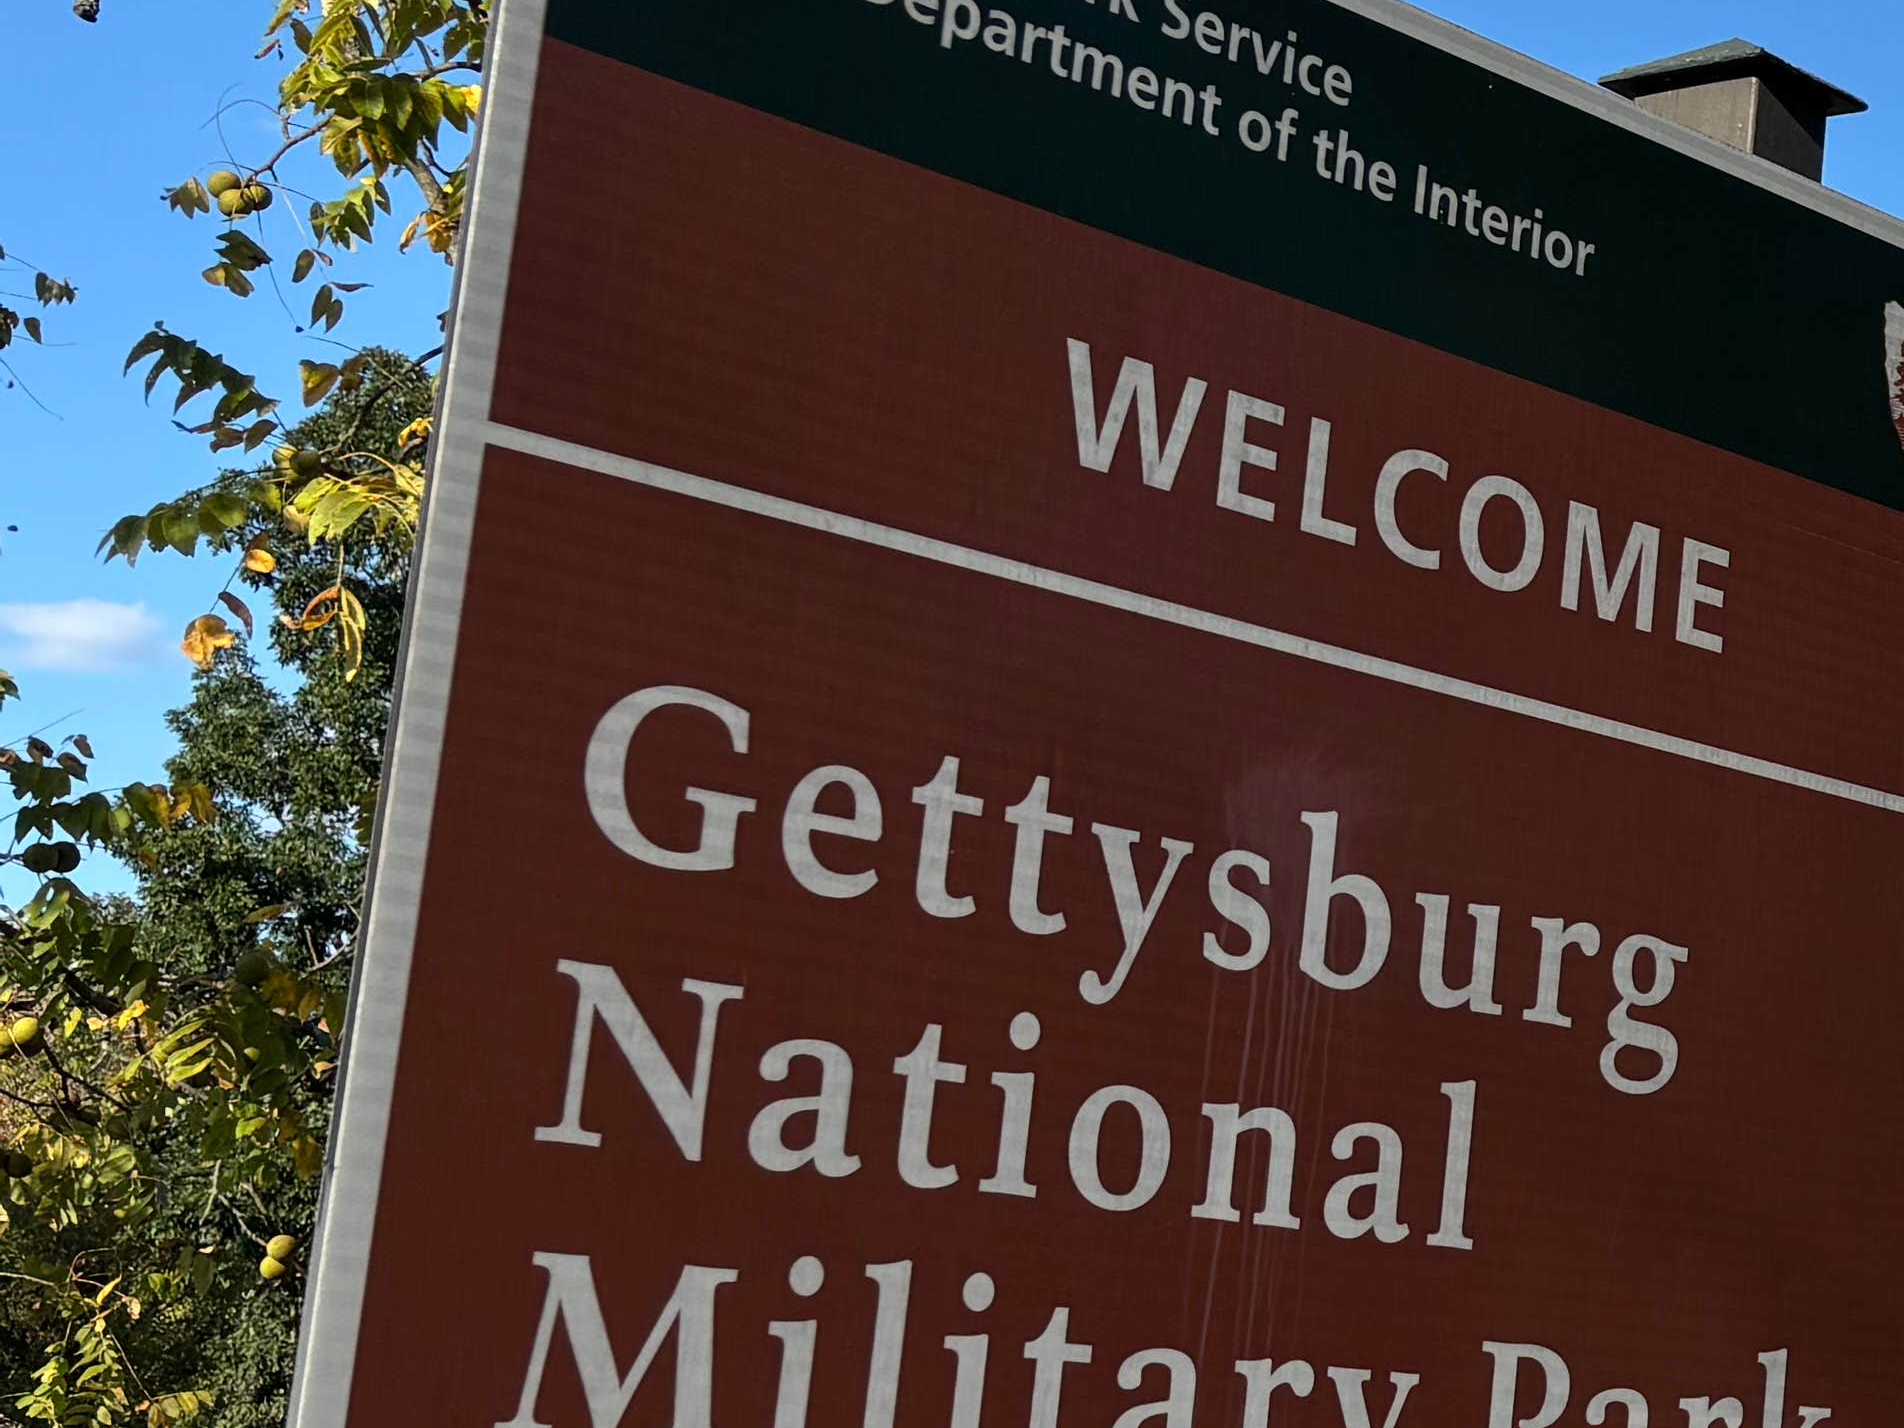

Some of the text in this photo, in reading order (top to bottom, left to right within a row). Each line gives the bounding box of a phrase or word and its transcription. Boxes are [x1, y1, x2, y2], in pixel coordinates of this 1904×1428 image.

[1238, 108, 1299, 162] of
[1312, 129, 1397, 202] the
[1414, 164, 1595, 277] Interior
[1066, 337, 1731, 654] WELCOME
[584, 685, 1689, 1095] Gettysburg
[534, 958, 1477, 1250] National
